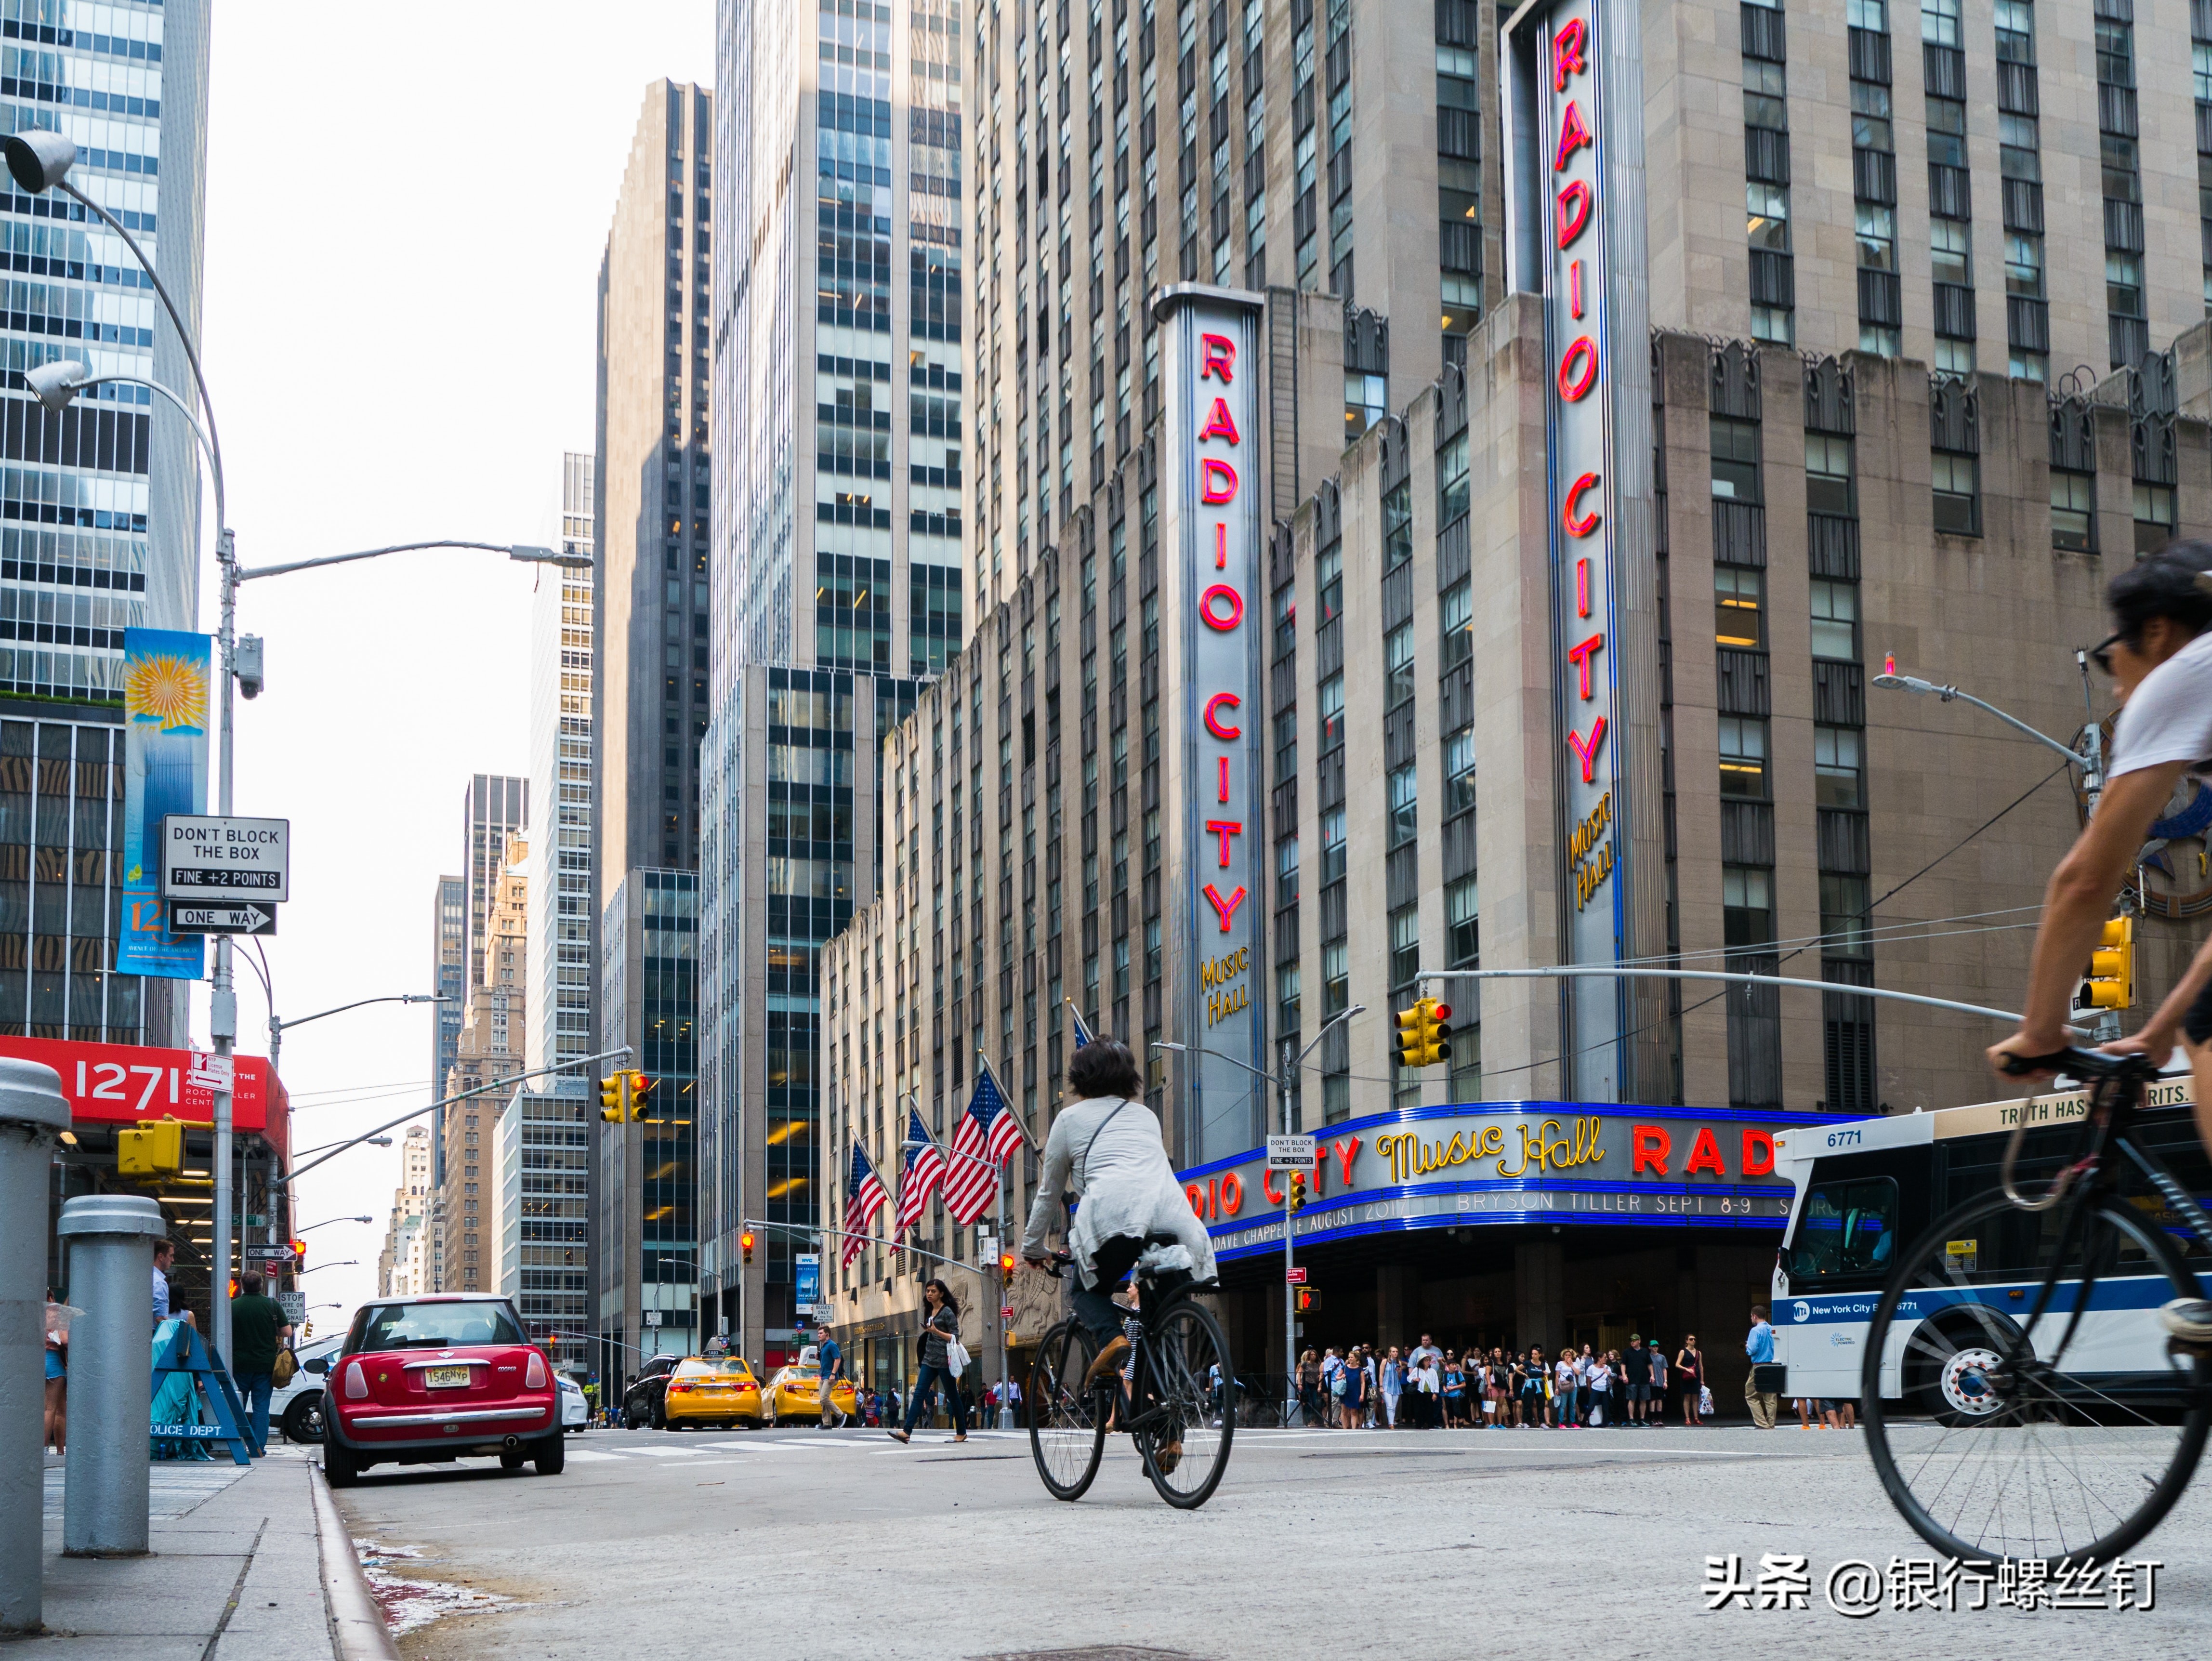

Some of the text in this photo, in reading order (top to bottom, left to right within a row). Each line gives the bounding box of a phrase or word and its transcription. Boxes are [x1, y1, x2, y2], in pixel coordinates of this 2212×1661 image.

[1554, 16, 1606, 783] RADIO CITY
[1198, 332, 1247, 931] RADIO CITY
[174, 828, 279, 844] DON'T BLOCK
[193, 845, 260, 860] THE BOX
[176, 870, 276, 886] FINE +2 POINTS
[185, 911, 260, 925] ONE WAY
[76, 1061, 179, 1110] 1271
[2055, 1098, 2085, 1118] HAS
[2147, 1085, 2189, 1106] RITS.
[1828, 1130, 1861, 1147] 6771
[1186, 1116, 1775, 1219] DIO CTY Music Hall RAD
[1214, 1192, 1751, 1251] DAVE CHAPPELE AUGUST 2017 BRYSON TILLER SEPT 8-9
[1793, 1306, 1807, 1318] MTA
[1813, 1306, 1830, 1315] New
[1832, 1305, 1851, 1314] York
[1853, 1304, 1870, 1314] City
[1896, 1302, 1917, 1310] 6771
[150, 1425, 183, 1435] OLICE
